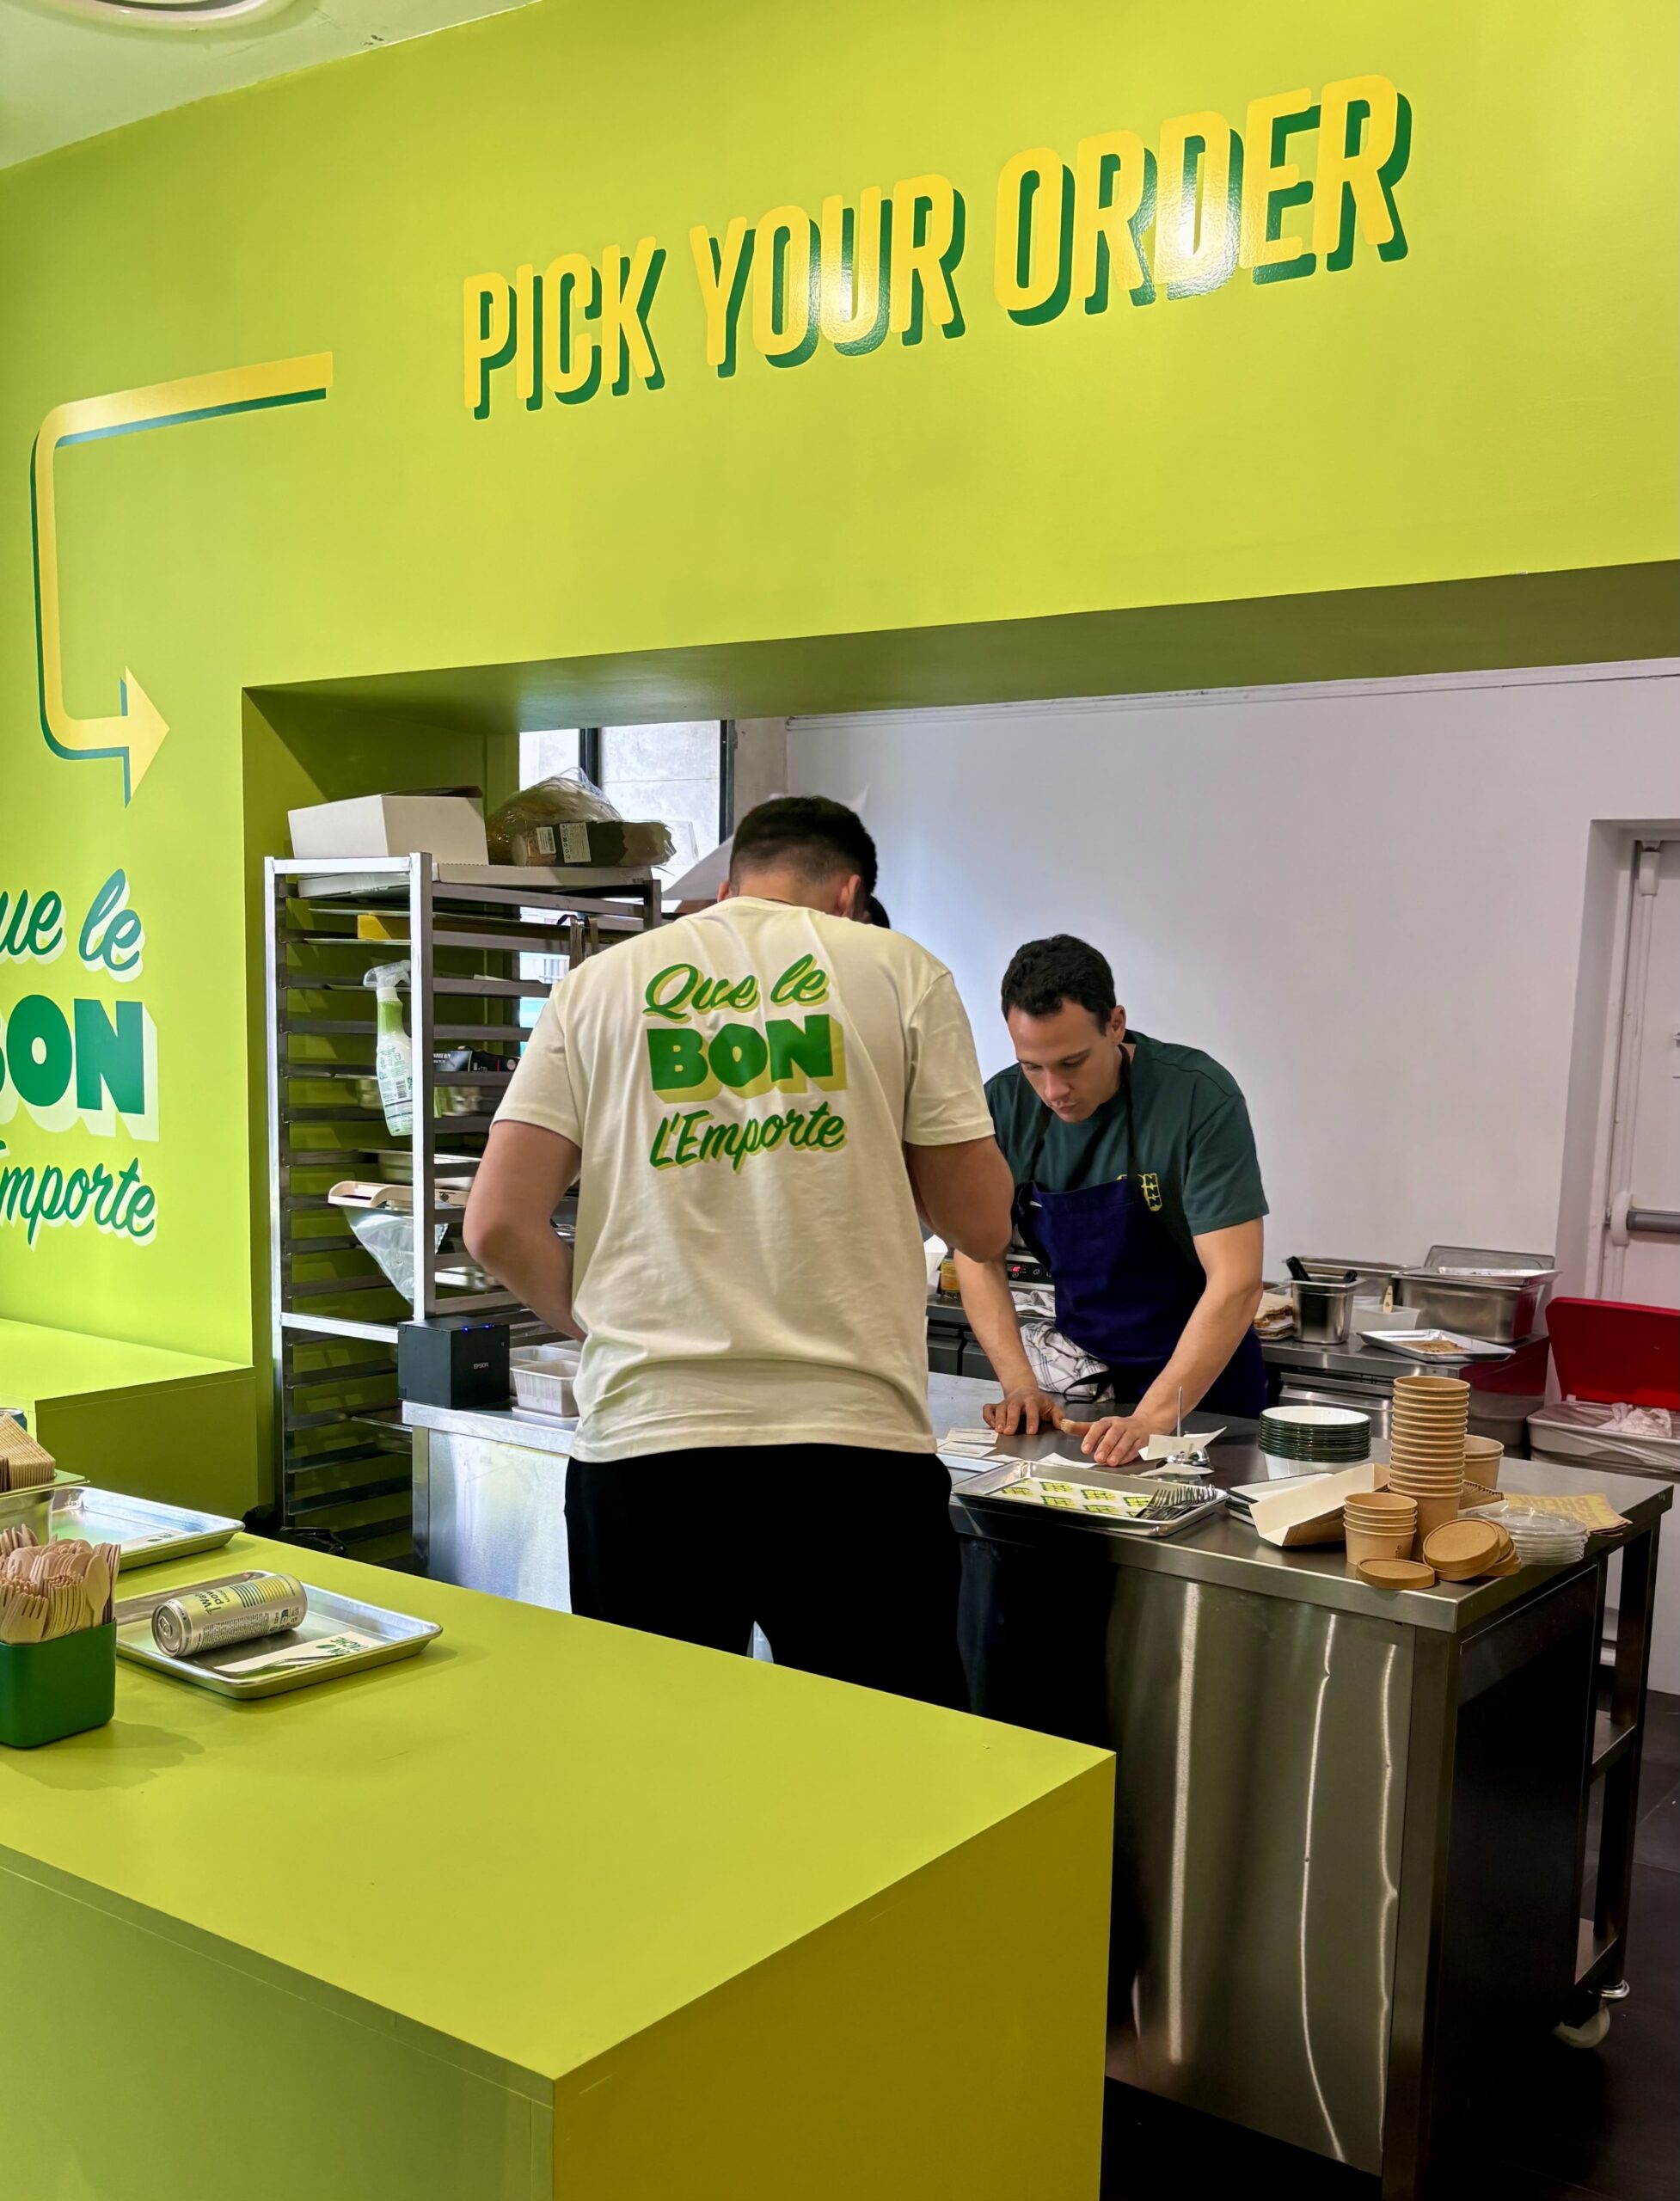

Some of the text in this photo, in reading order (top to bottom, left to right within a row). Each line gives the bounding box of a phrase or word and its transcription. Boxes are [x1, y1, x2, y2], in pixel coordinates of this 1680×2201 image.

[463, 75, 1412, 420] PICK YOUR ORDER
[0, 868, 144, 982] ue le
[642, 953, 829, 1023] Que le
[0, 994, 158, 1141] ON
[647, 1014, 848, 1103] BON
[649, 1101, 848, 1174] L'Emporte
[0, 1143, 156, 1250] mporte
